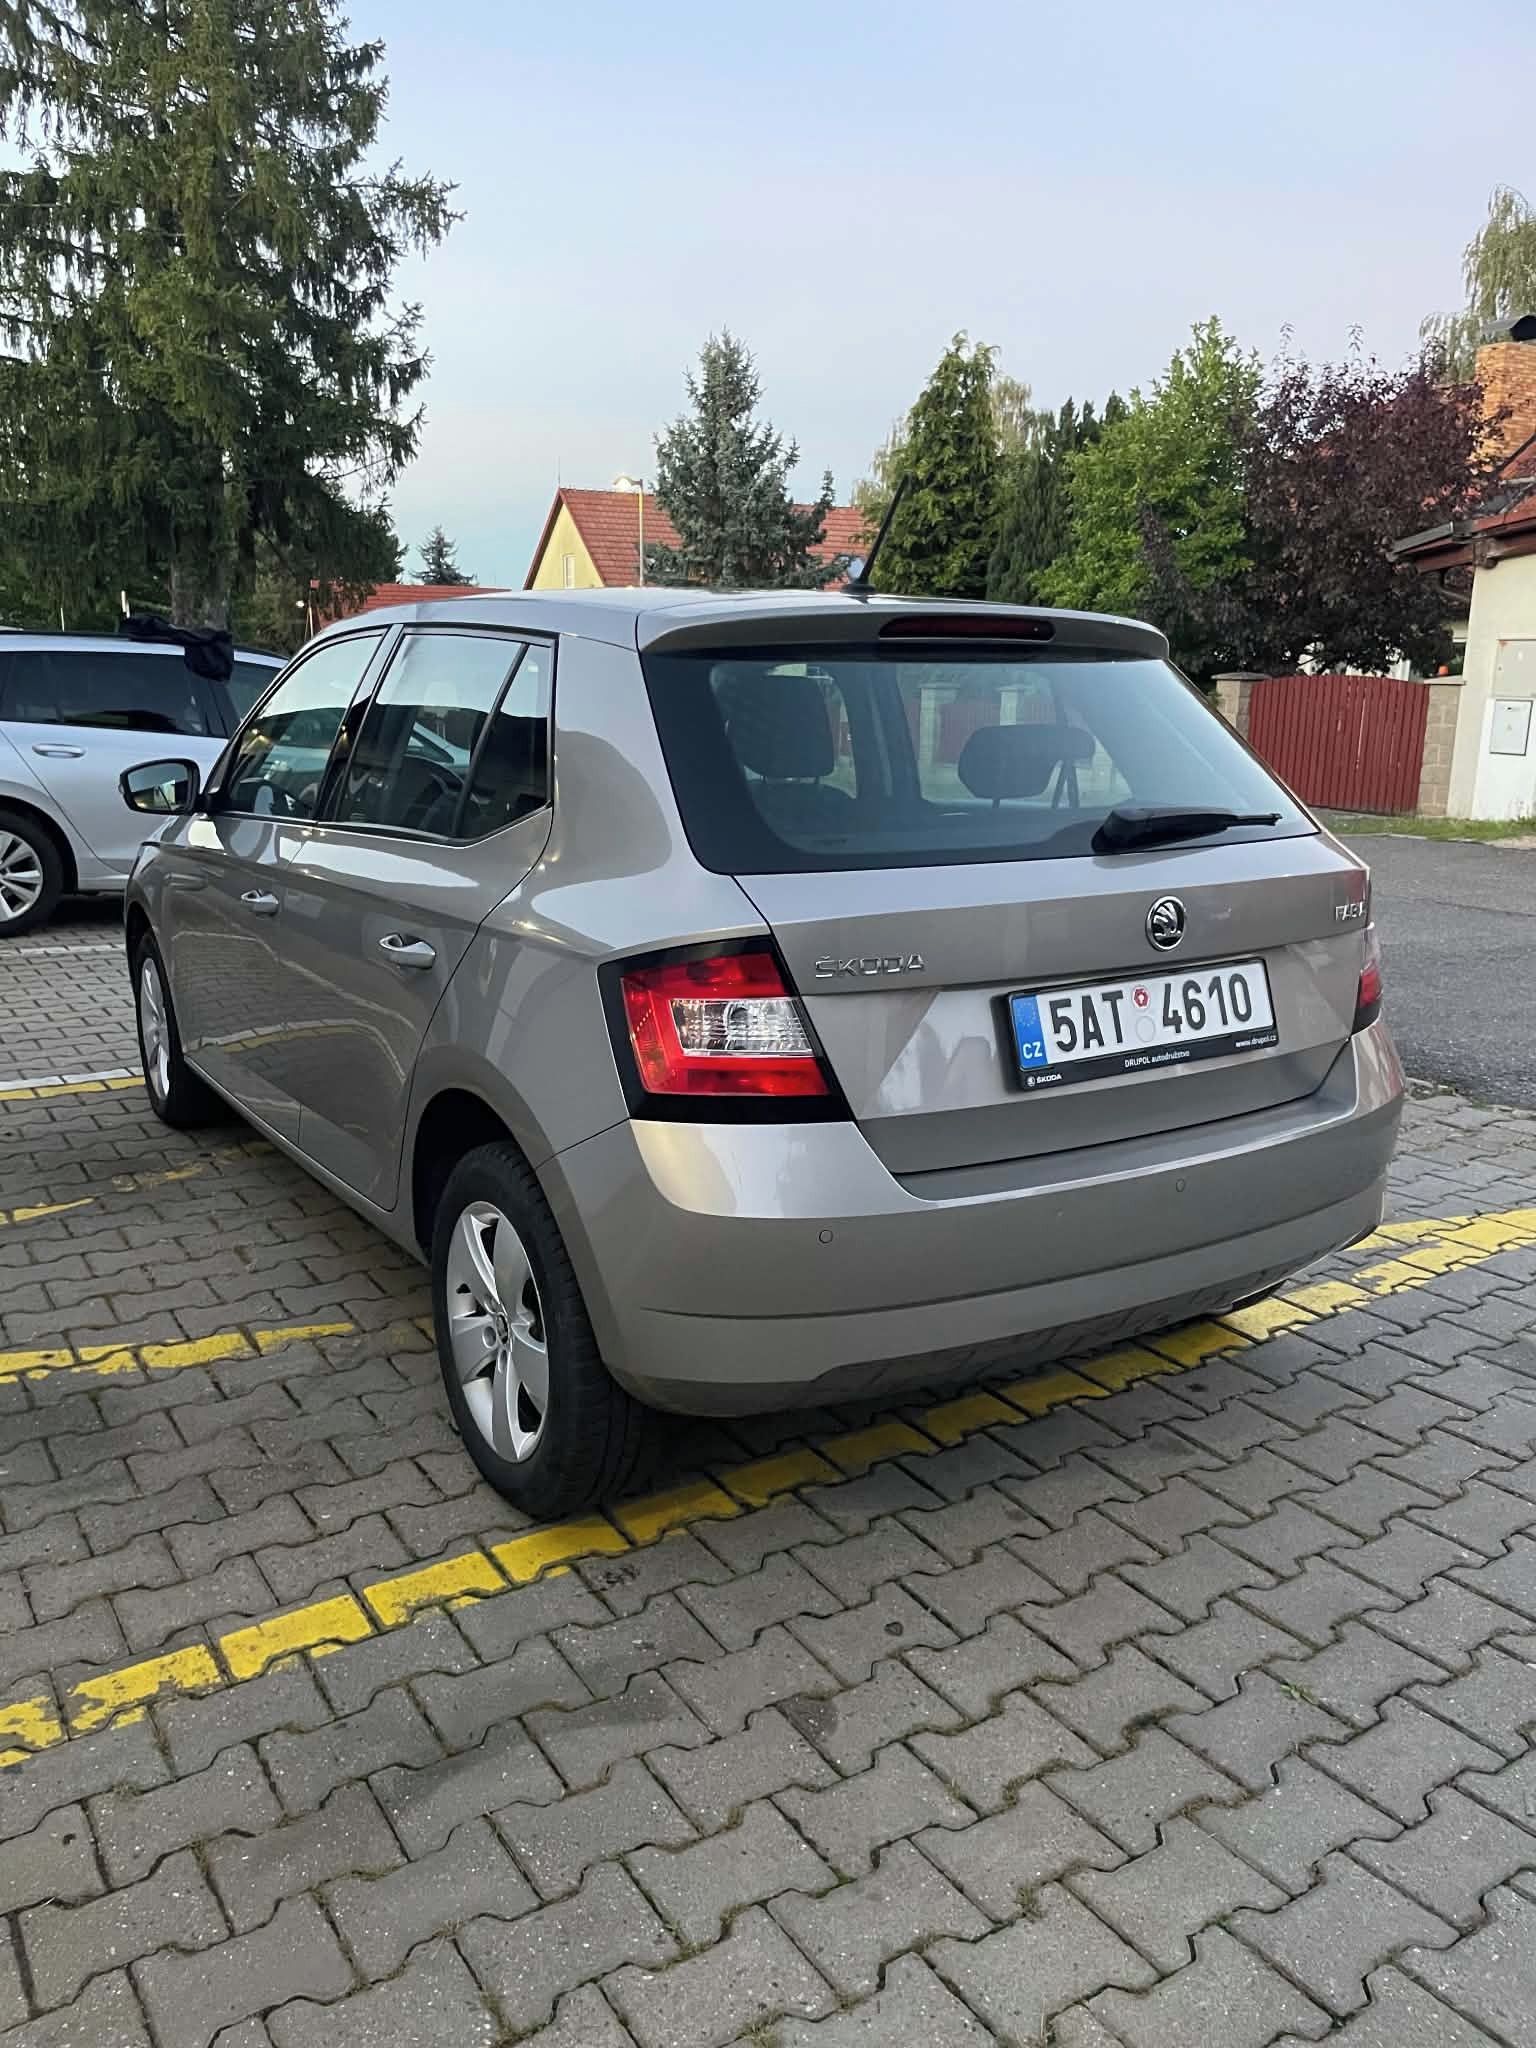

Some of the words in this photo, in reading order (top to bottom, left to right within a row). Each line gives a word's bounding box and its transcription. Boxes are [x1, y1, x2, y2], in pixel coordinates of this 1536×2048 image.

[815, 954, 924, 978] ŠKODA
[1050, 989, 1124, 1053] 5AT
[1161, 973, 1253, 1035] 4610
[1022, 1041, 1043, 1060] CZ
[1124, 1056, 1151, 1068] DRUPOL
[1036, 1073, 1063, 1084] ŠKODA
